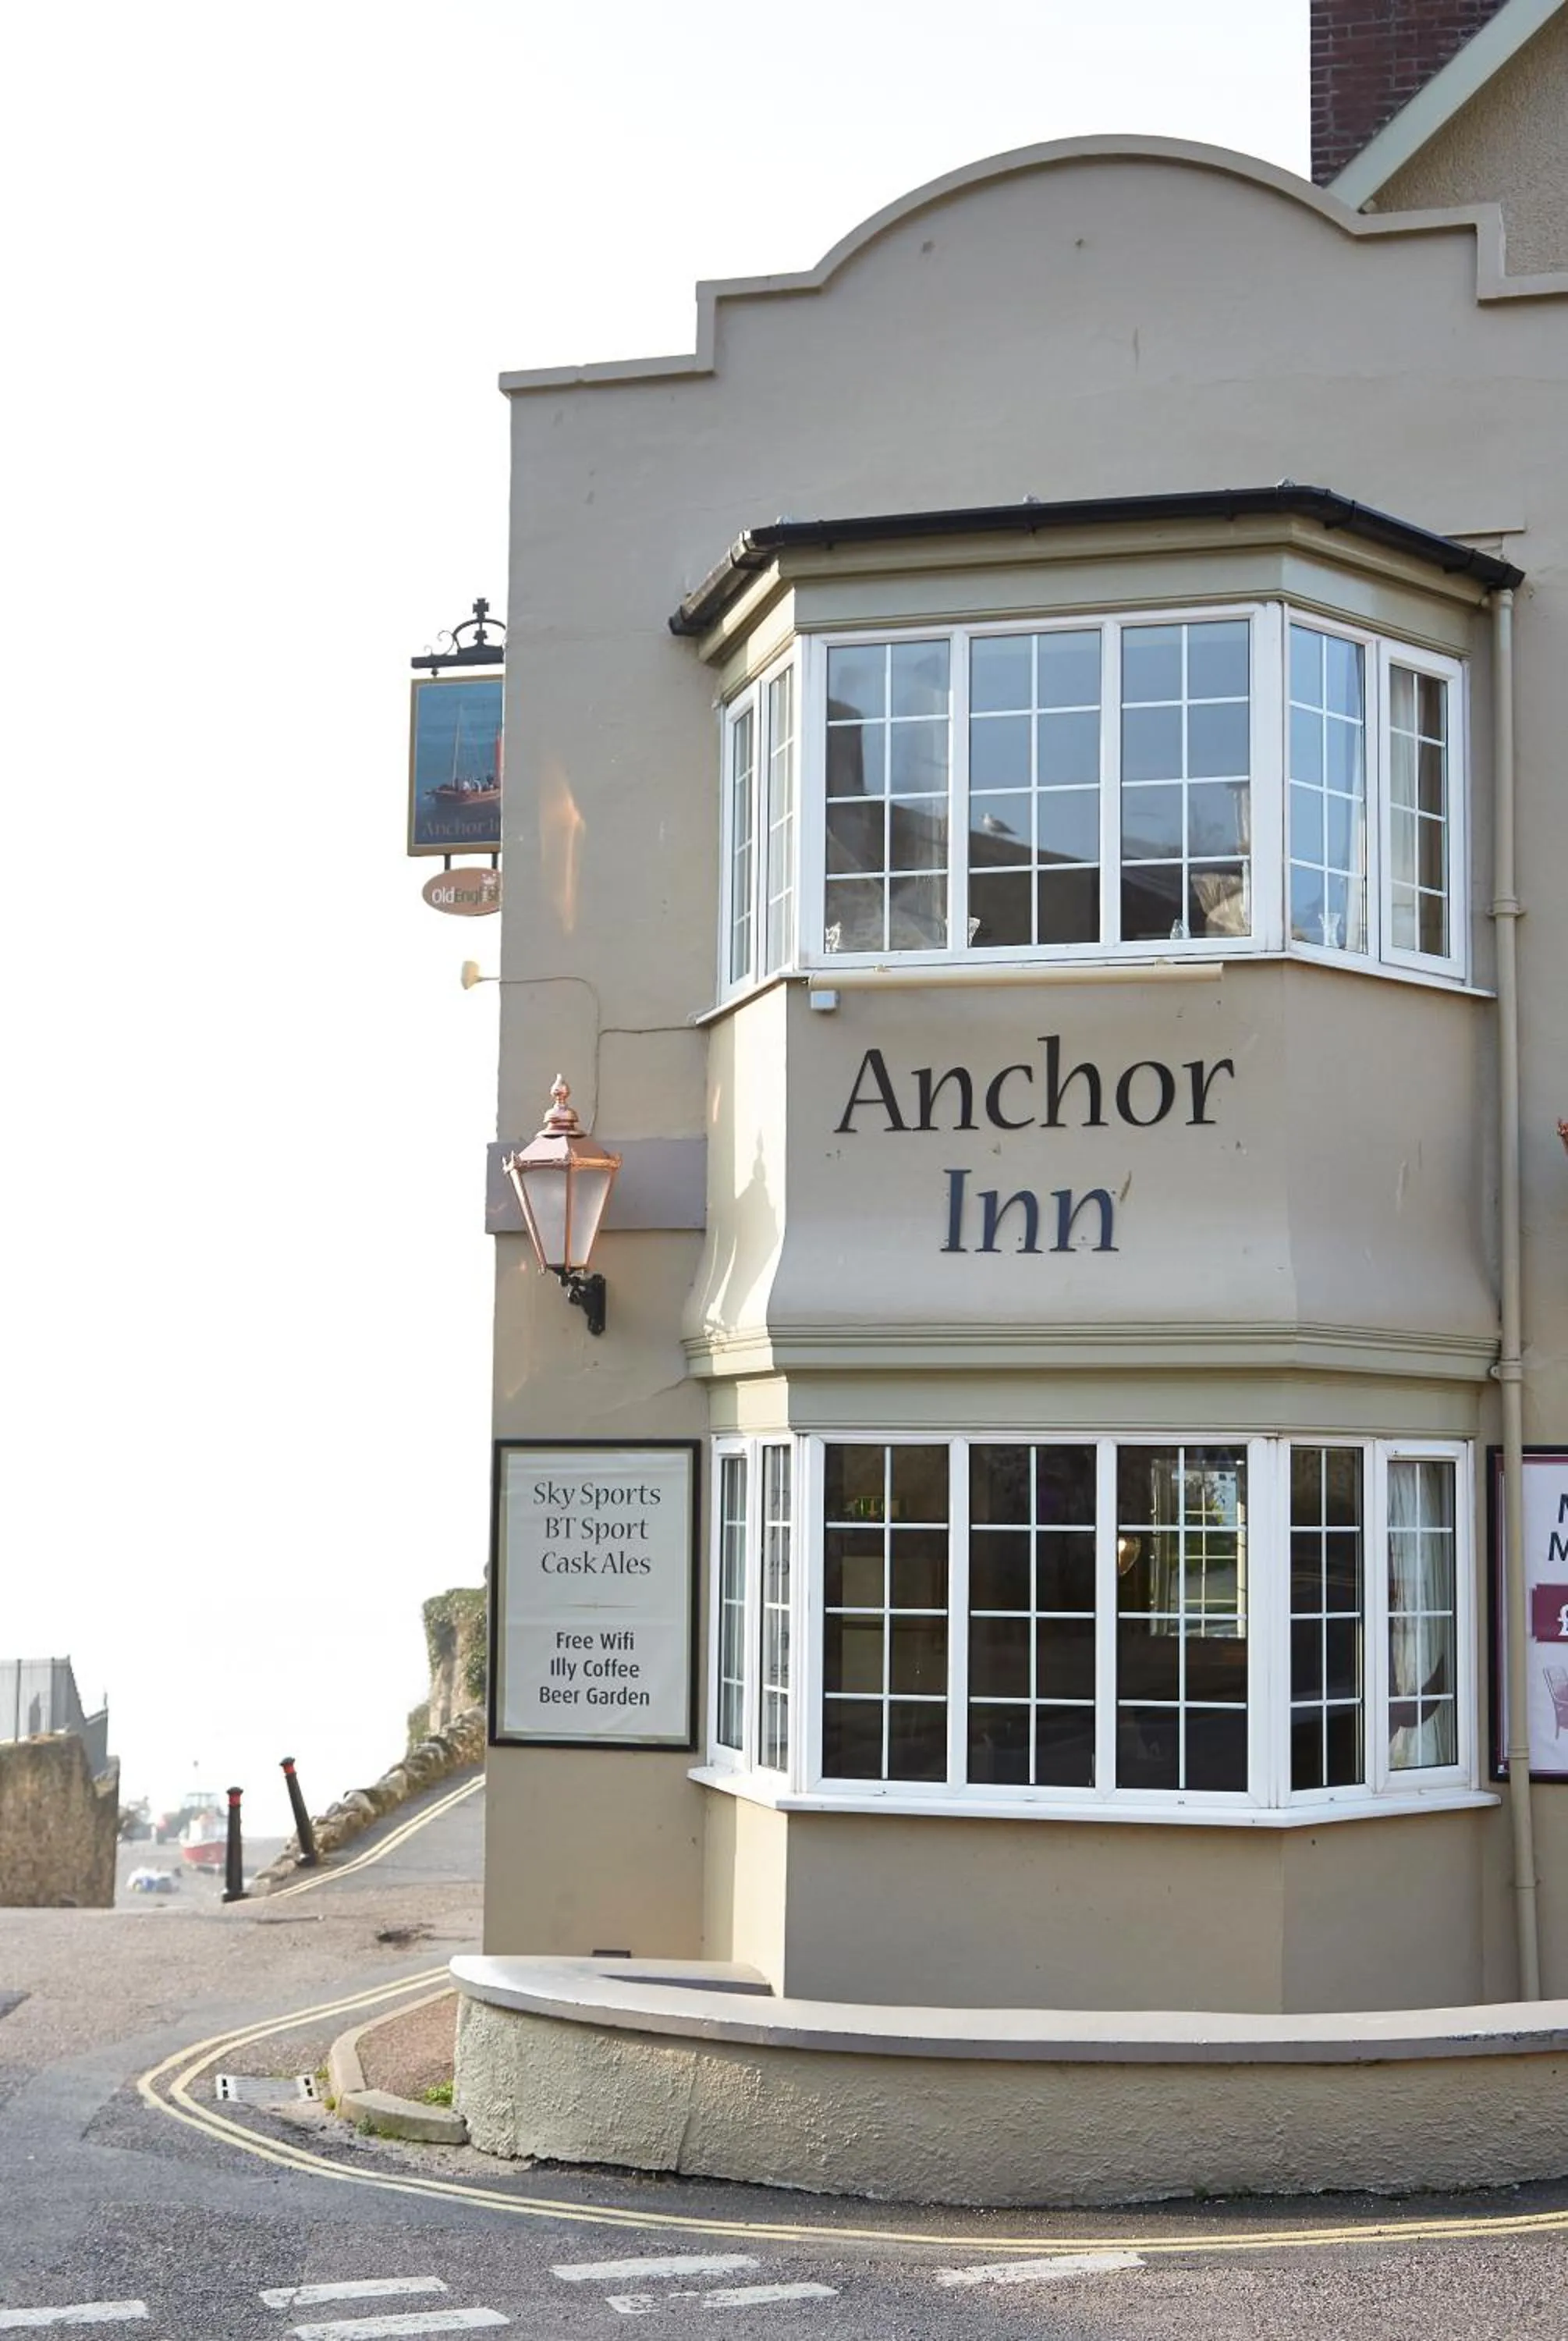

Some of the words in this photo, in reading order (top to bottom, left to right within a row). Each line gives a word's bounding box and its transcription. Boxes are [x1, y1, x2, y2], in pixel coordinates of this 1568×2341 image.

[422, 817, 484, 838] Anchor
[833, 1035, 1235, 1134] Anchor
[940, 1169, 1119, 1253] Inn
[534, 1481, 575, 1510] Sky
[580, 1483, 661, 1511] Sports
[545, 1517, 576, 1539] BT
[581, 1517, 648, 1545] Sport
[541, 1551, 597, 1574] Cask
[601, 1551, 651, 1575] Ales
[556, 1632, 593, 1650] Free
[600, 1632, 634, 1650] Wifi
[550, 1657, 576, 1681] Illy
[584, 1658, 640, 1678] Coffee
[539, 1686, 580, 1704] Beer
[587, 1686, 650, 1706] Garden
